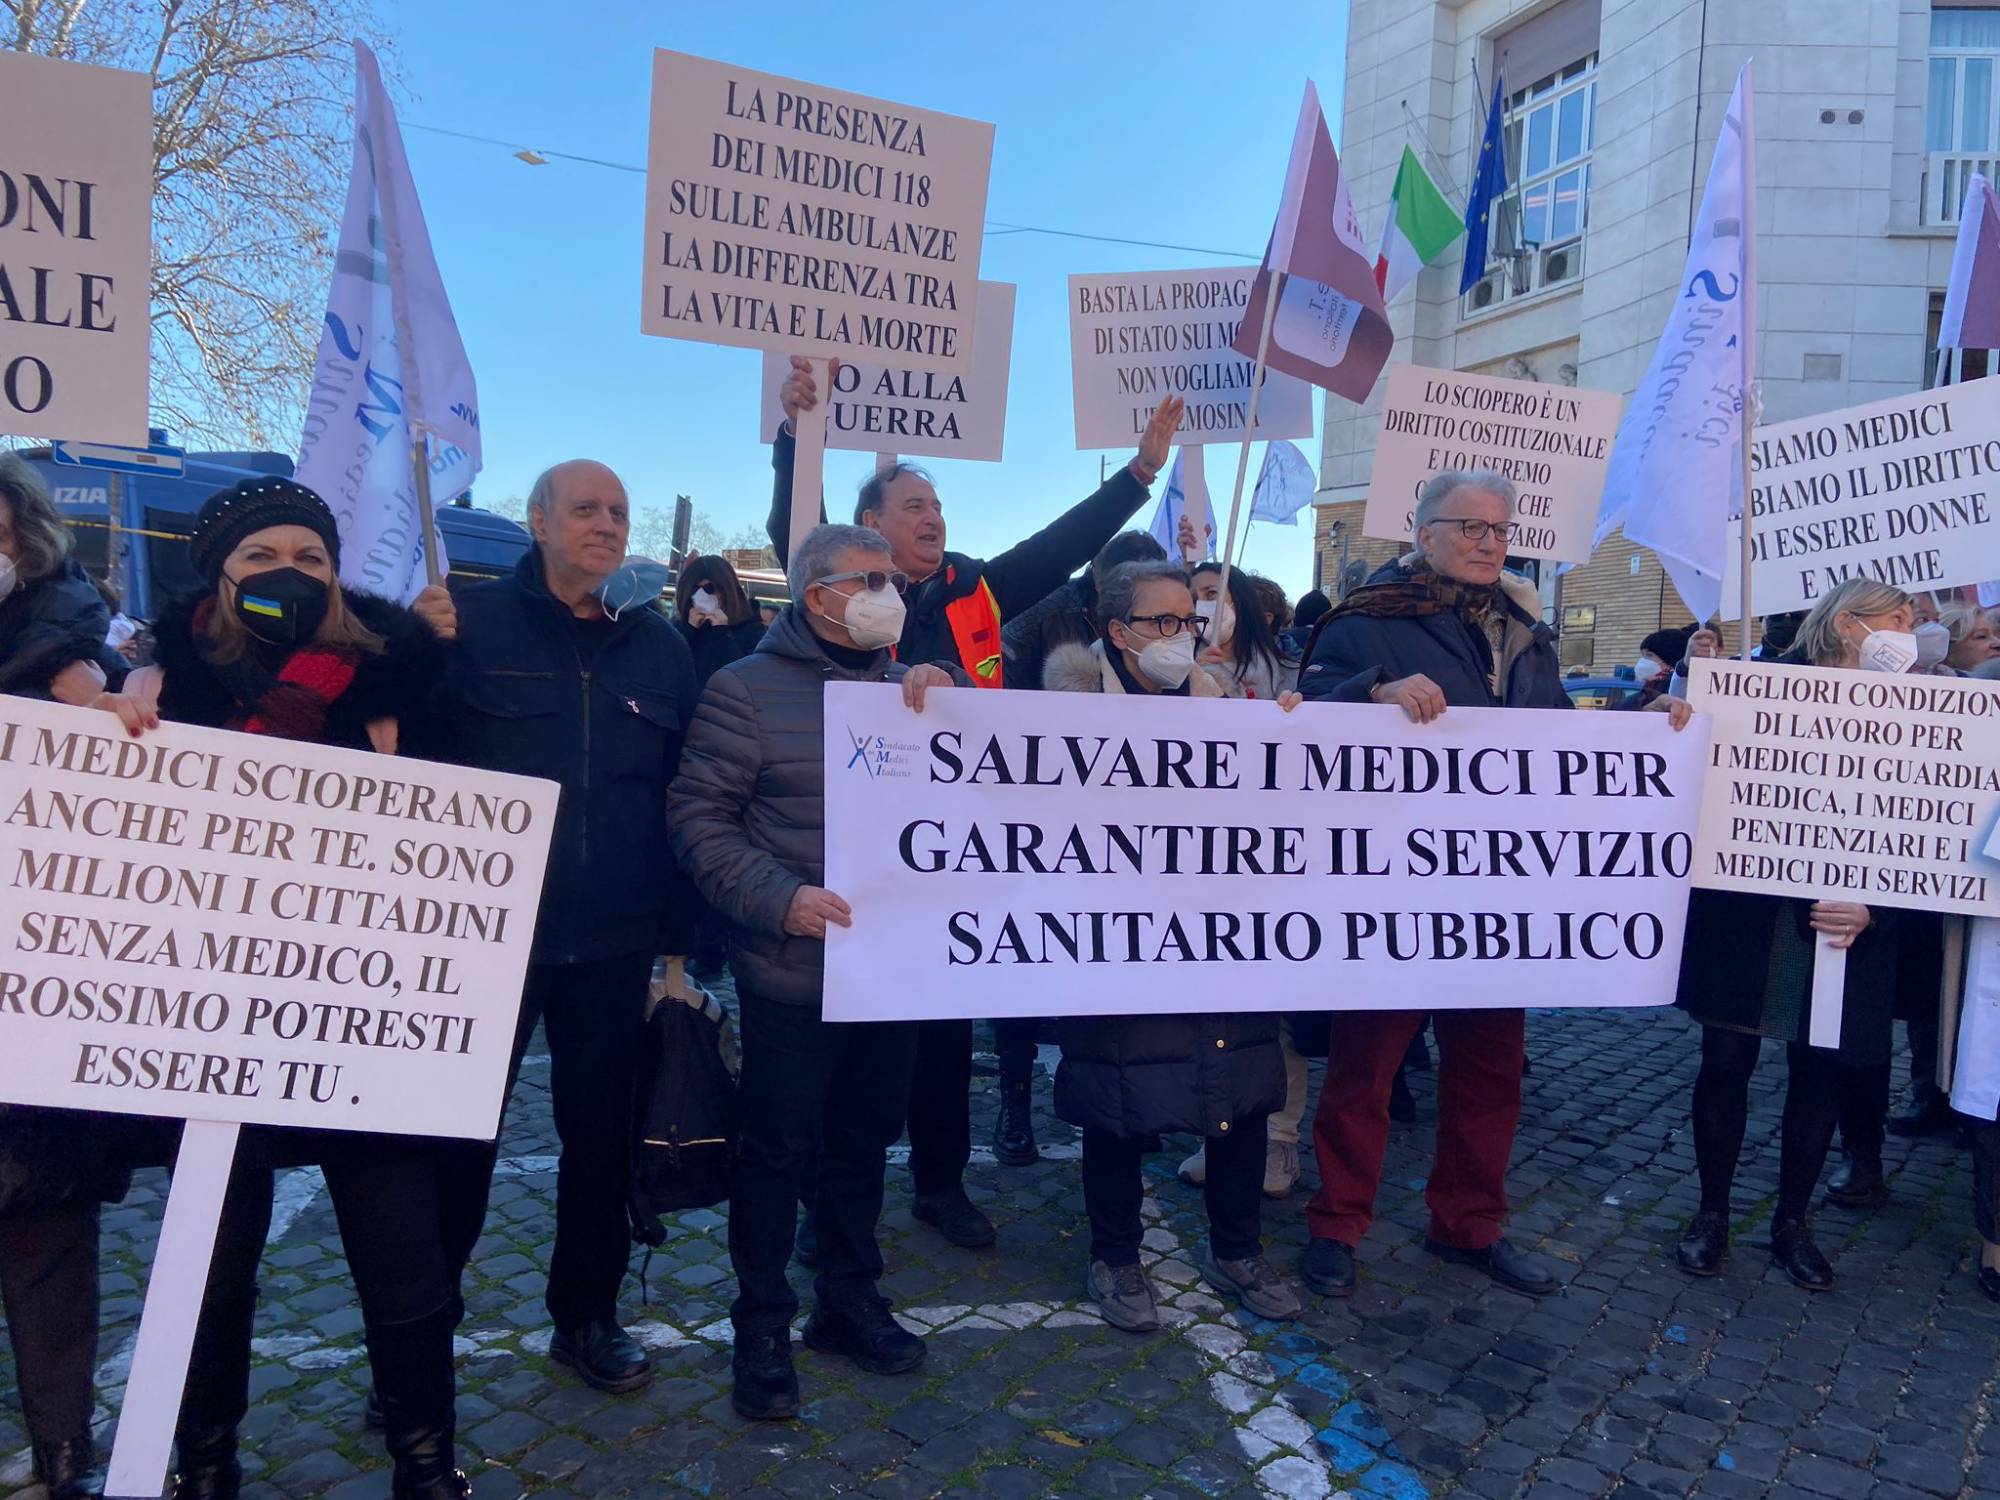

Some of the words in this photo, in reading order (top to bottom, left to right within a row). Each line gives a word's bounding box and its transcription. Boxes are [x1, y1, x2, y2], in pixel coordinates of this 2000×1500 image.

[726, 80, 767, 123] LA
[775, 91, 926, 156] PRESENZA
[710, 133, 765, 176] DEI
[774, 146, 885, 199] MEDICI
[893, 170, 931, 208] 118
[670, 179, 769, 230] SULLE
[776, 201, 957, 262] AMBULANZE
[661, 231, 704, 272] LA
[711, 240, 897, 301] DIFFERENZA
[904, 272, 957, 311] TRA
[1079, 284, 1139, 314] BASTA
[1143, 283, 1168, 311] LA
[1172, 279, 1254, 310] PROPAG
[661, 285, 704, 323] LA
[711, 292, 781, 334] VITA
[789, 304, 806, 337] E
[815, 308, 852, 344] LA
[858, 314, 957, 358] MORTE
[1095, 326, 1114, 355] DI
[1119, 324, 1178, 353] STATO
[1182, 323, 1213, 351] SUI
[833, 364, 861, 393] O
[872, 369, 968, 403] ALLA
[1117, 366, 1158, 394] NON
[1425, 381, 1449, 405] LO
[1451, 384, 1537, 417] SCIOPERO
[1540, 390, 1553, 419] È
[1556, 399, 1581, 423] UN
[826, 402, 963, 440] UERRA
[1384, 409, 1455, 439] DIRITTO
[1458, 419, 1607, 460] COSTITUZIONALE
[1751, 426, 1838, 472] SIAMO
[1843, 402, 1953, 452] MEDICI
[1428, 448, 1440, 470] E
[1728, 472, 1841, 521] BIAMO
[1848, 467, 1878, 498] IL
[1882, 440, 2000, 493] DIRITTO
[54, 487, 107, 504] IZIA
[1518, 493, 1553, 519] CHE
[1514, 525, 1556, 551] ARIO
[1775, 512, 1880, 558] ESSERE
[1885, 492, 1991, 540] DONNE
[1800, 570, 1819, 600] E
[1708, 672, 1842, 705] MIGLIORI
[1754, 711, 1782, 736] DI
[1790, 714, 1903, 746] LAVORO
[1910, 724, 1964, 752] PER
[0, 723, 22, 762] I
[30, 727, 225, 792] MEDICI
[233, 759, 532, 834] SCIOPERANO
[929, 731, 1240, 790] SALVARE
[1259, 742, 1283, 791] I
[1301, 743, 1536, 796] MEDICI
[1553, 750, 1676, 798] PER
[1712, 743, 1722, 767] I
[1729, 745, 1834, 776] MEDICI
[1837, 754, 1866, 780] DI
[1874, 757, 2000, 792] GUARDIA
[1730, 781, 1846, 819] MEDICA,
[1855, 792, 1864, 816] I
[1872, 794, 1975, 826] MEDICI
[4, 787, 189, 847] ANCHE
[199, 812, 294, 862] PER
[311, 827, 376, 872] TE.
[390, 839, 514, 888] SONO
[898, 819, 1307, 875] GARANTIRE
[1326, 828, 1391, 876] IL
[1407, 829, 1693, 878] SERVIZIO
[1730, 817, 1926, 858] PENITENZIARI
[1935, 836, 1950, 861] E
[1960, 838, 1969, 863] I
[10, 848, 230, 911] MILIONI
[236, 876, 260, 915] I
[270, 881, 512, 943] CITTADINI
[1714, 852, 1815, 884] MEDICI
[1823, 862, 1869, 890] DEI
[1877, 867, 1988, 902] SERVIZI
[16, 911, 182, 968] SENZA
[192, 931, 402, 998] MEDICO,
[414, 955, 461, 996] IL
[948, 911, 1321, 965] SANITARIO
[1340, 911, 1664, 961] PUBBLICO
[0, 972, 230, 1033] ROSSIMO
[240, 997, 477, 1055] POTRESTI
[71, 1043, 264, 1097] ESSERE
